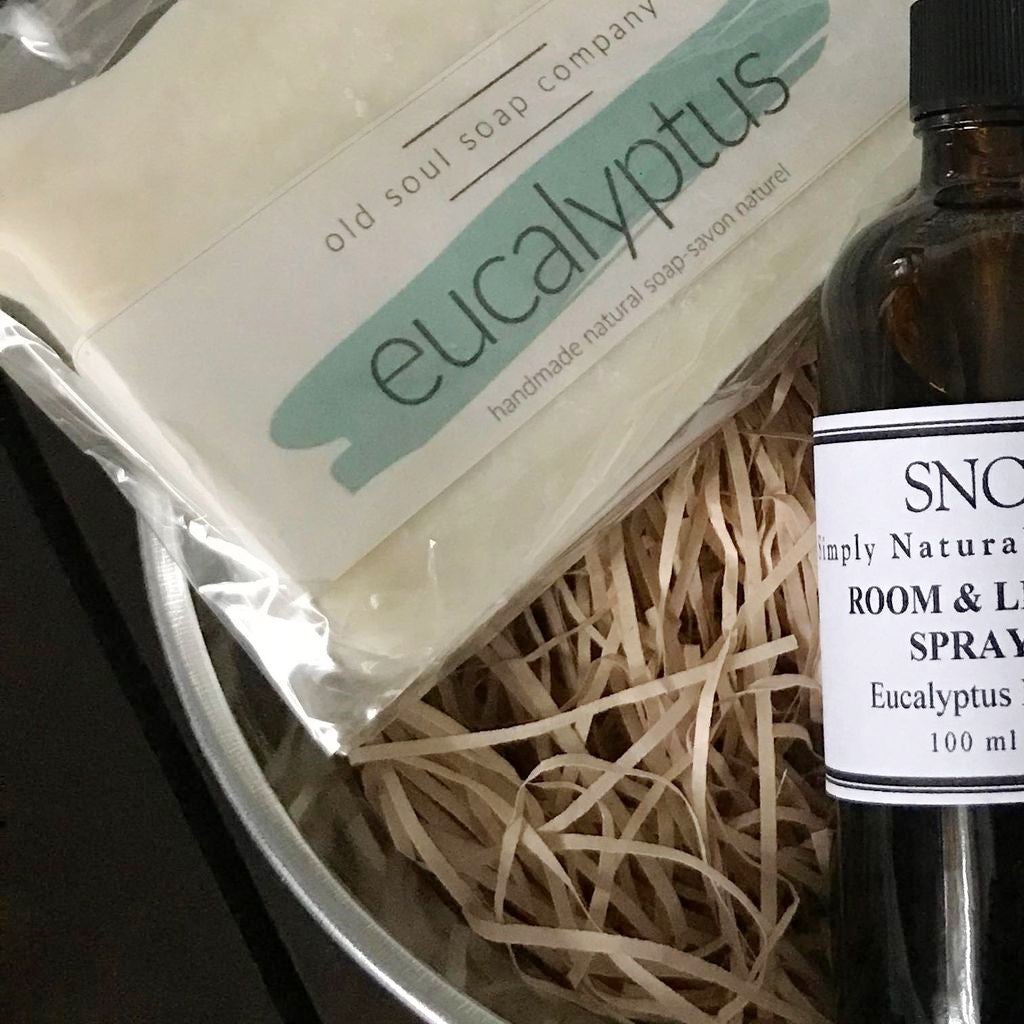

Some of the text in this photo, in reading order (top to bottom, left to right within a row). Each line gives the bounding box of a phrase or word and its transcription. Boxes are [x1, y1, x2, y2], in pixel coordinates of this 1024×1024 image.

[324, 203, 376, 254] old
[385, 148, 451, 208] soul
[459, 95, 529, 151] soap
[369, 48, 793, 409] eucalyptus
[487, 162, 792, 422] handmade natural soap-savon naturel
[848, 584, 942, 615] ROOM
[953, 583, 982, 614] &
[871, 681, 1011, 717] Eucalyptus
[931, 728, 1018, 753] 100 ml
